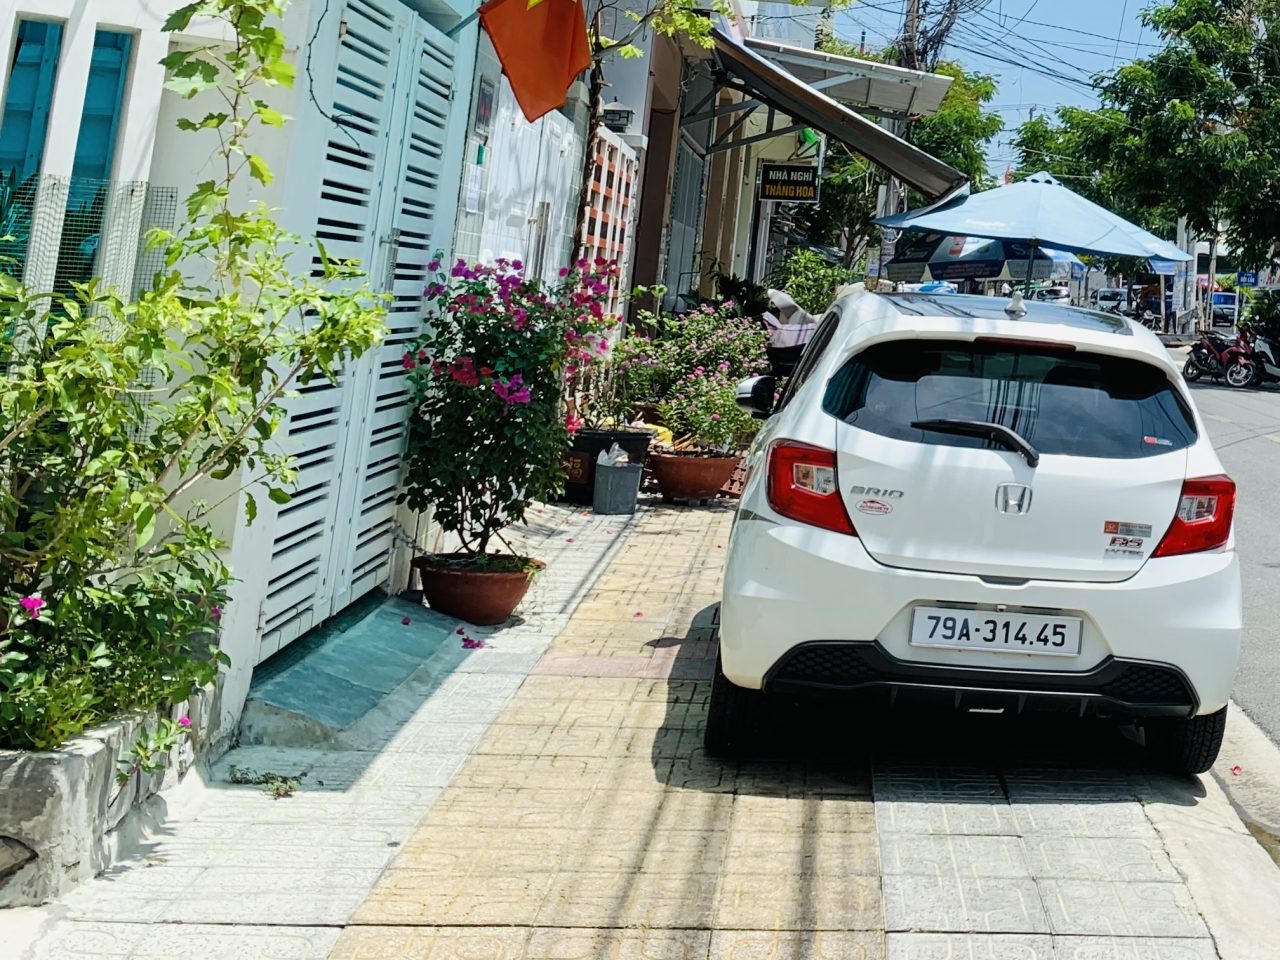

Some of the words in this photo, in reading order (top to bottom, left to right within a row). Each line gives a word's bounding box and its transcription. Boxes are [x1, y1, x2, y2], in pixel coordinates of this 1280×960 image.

[769, 169, 788, 180] NHÀ
[790, 169, 813, 182] NGHỈ
[796, 186, 814, 198] HOA
[850, 485, 904, 498] BRIO
[1109, 535, 1144, 549] RS
[927, 615, 1067, 647] 79A-314.45
